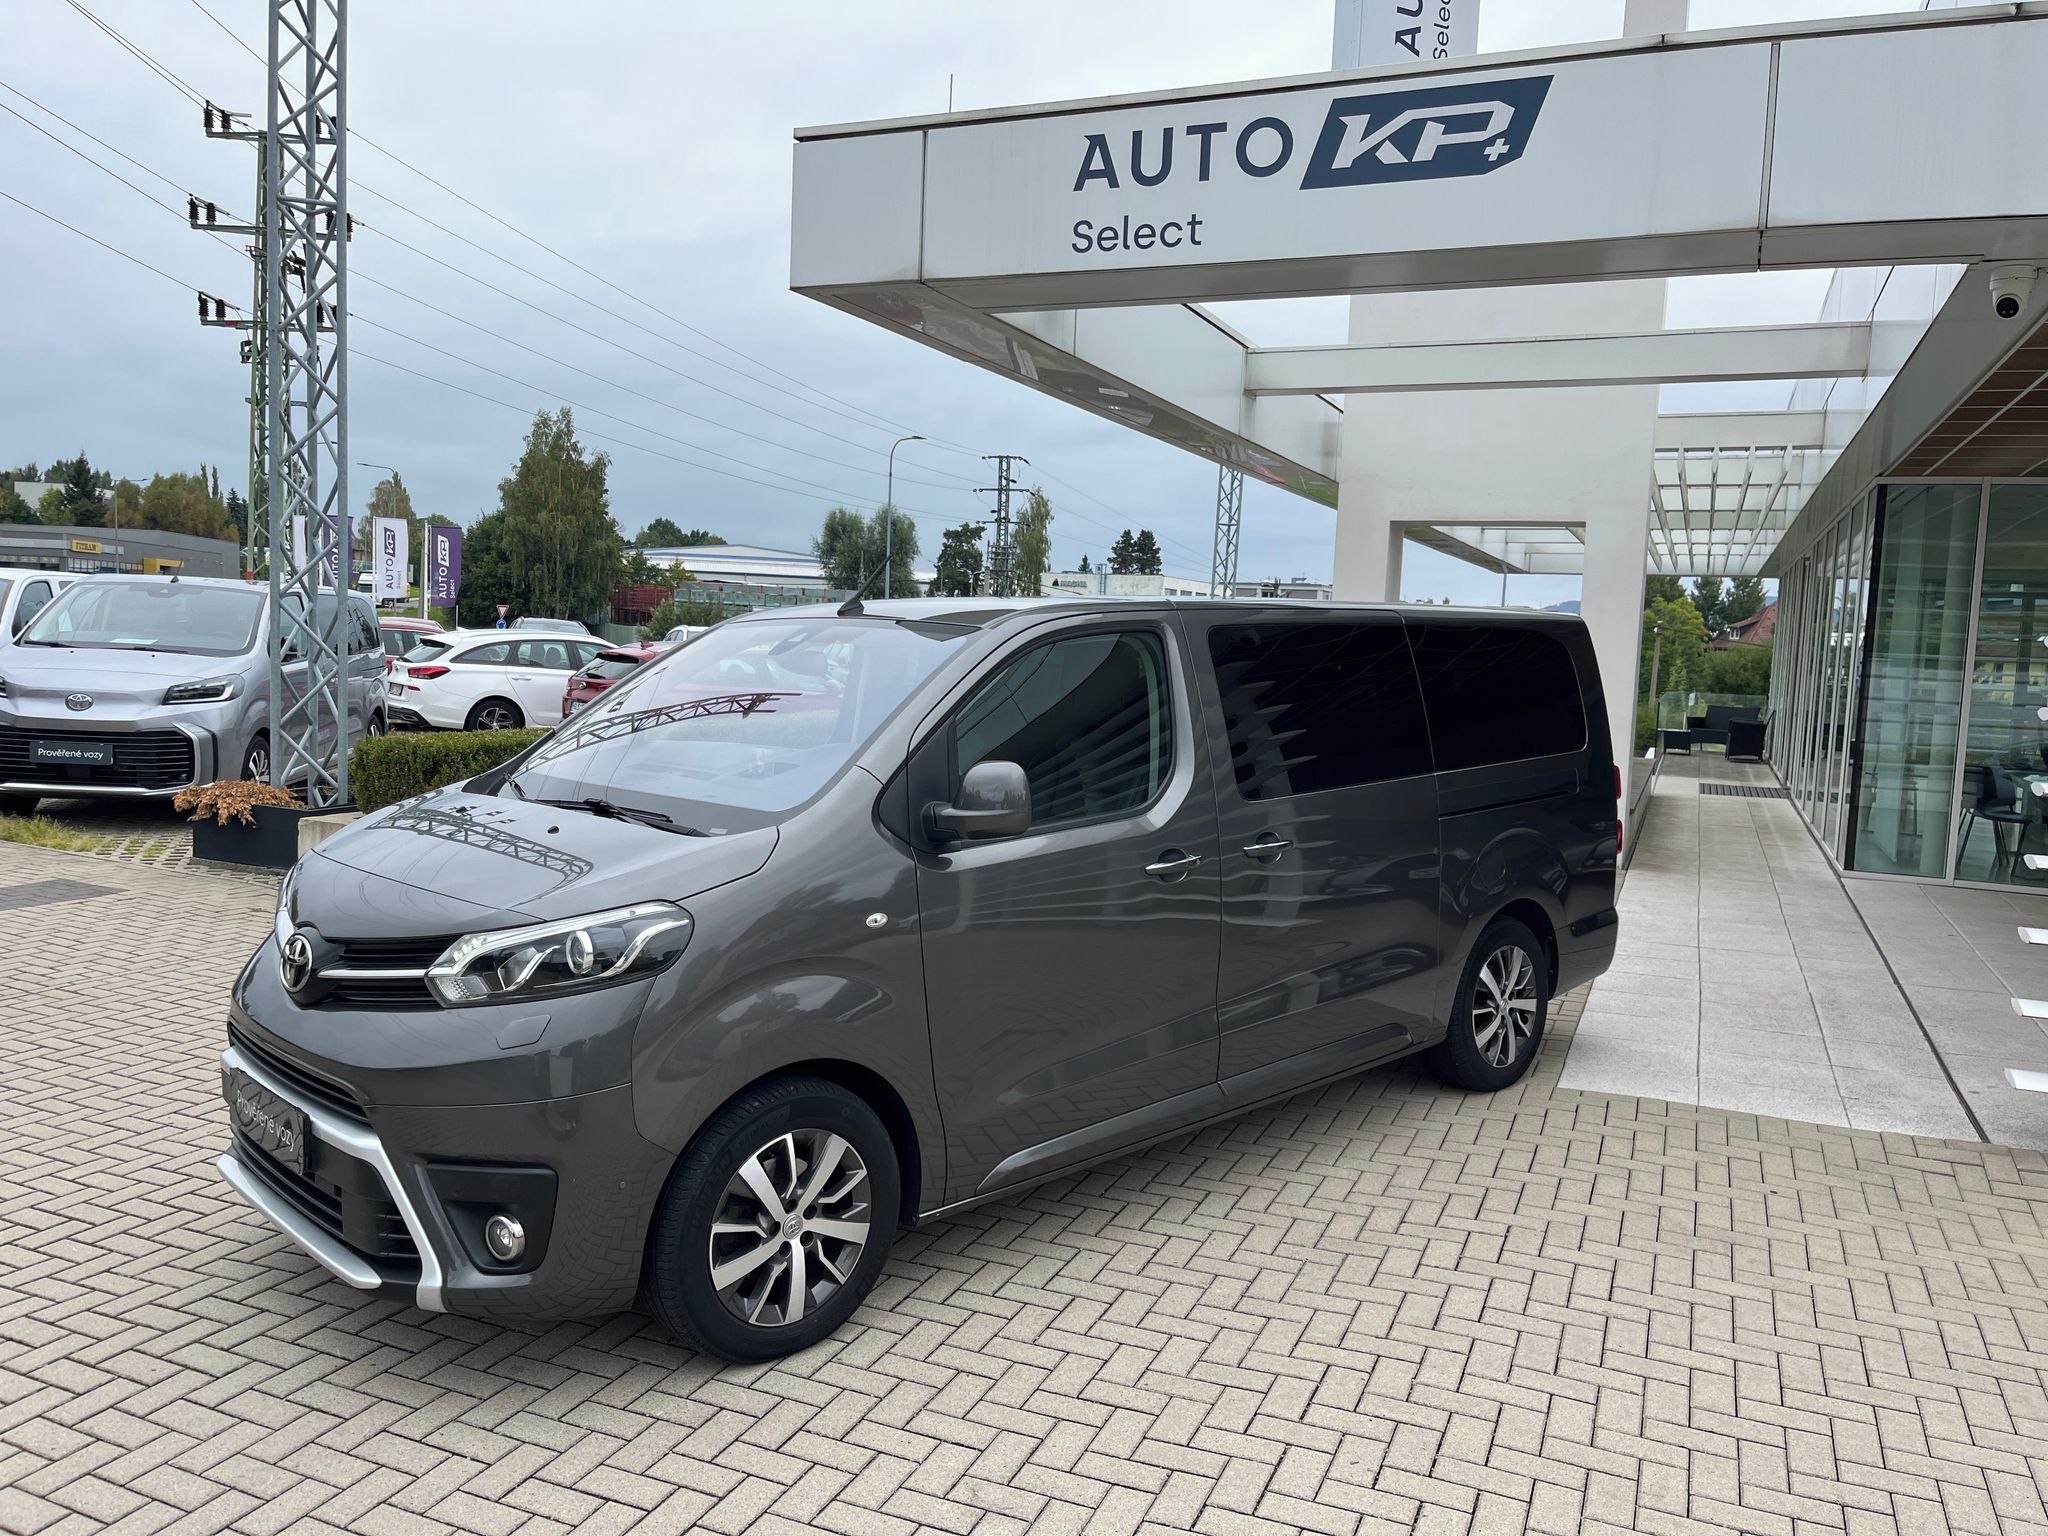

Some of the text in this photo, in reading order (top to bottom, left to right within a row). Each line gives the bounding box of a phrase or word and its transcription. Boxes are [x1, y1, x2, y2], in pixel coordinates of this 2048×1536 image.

[1073, 117, 1294, 192] AUTO
[1071, 214, 1203, 253] Select
[386, 558, 394, 590] AUTO
[439, 567, 448, 599] AUTO
[37, 748, 104, 761] Prověřené vozy
[237, 1089, 296, 1152] Prověřené vozy
